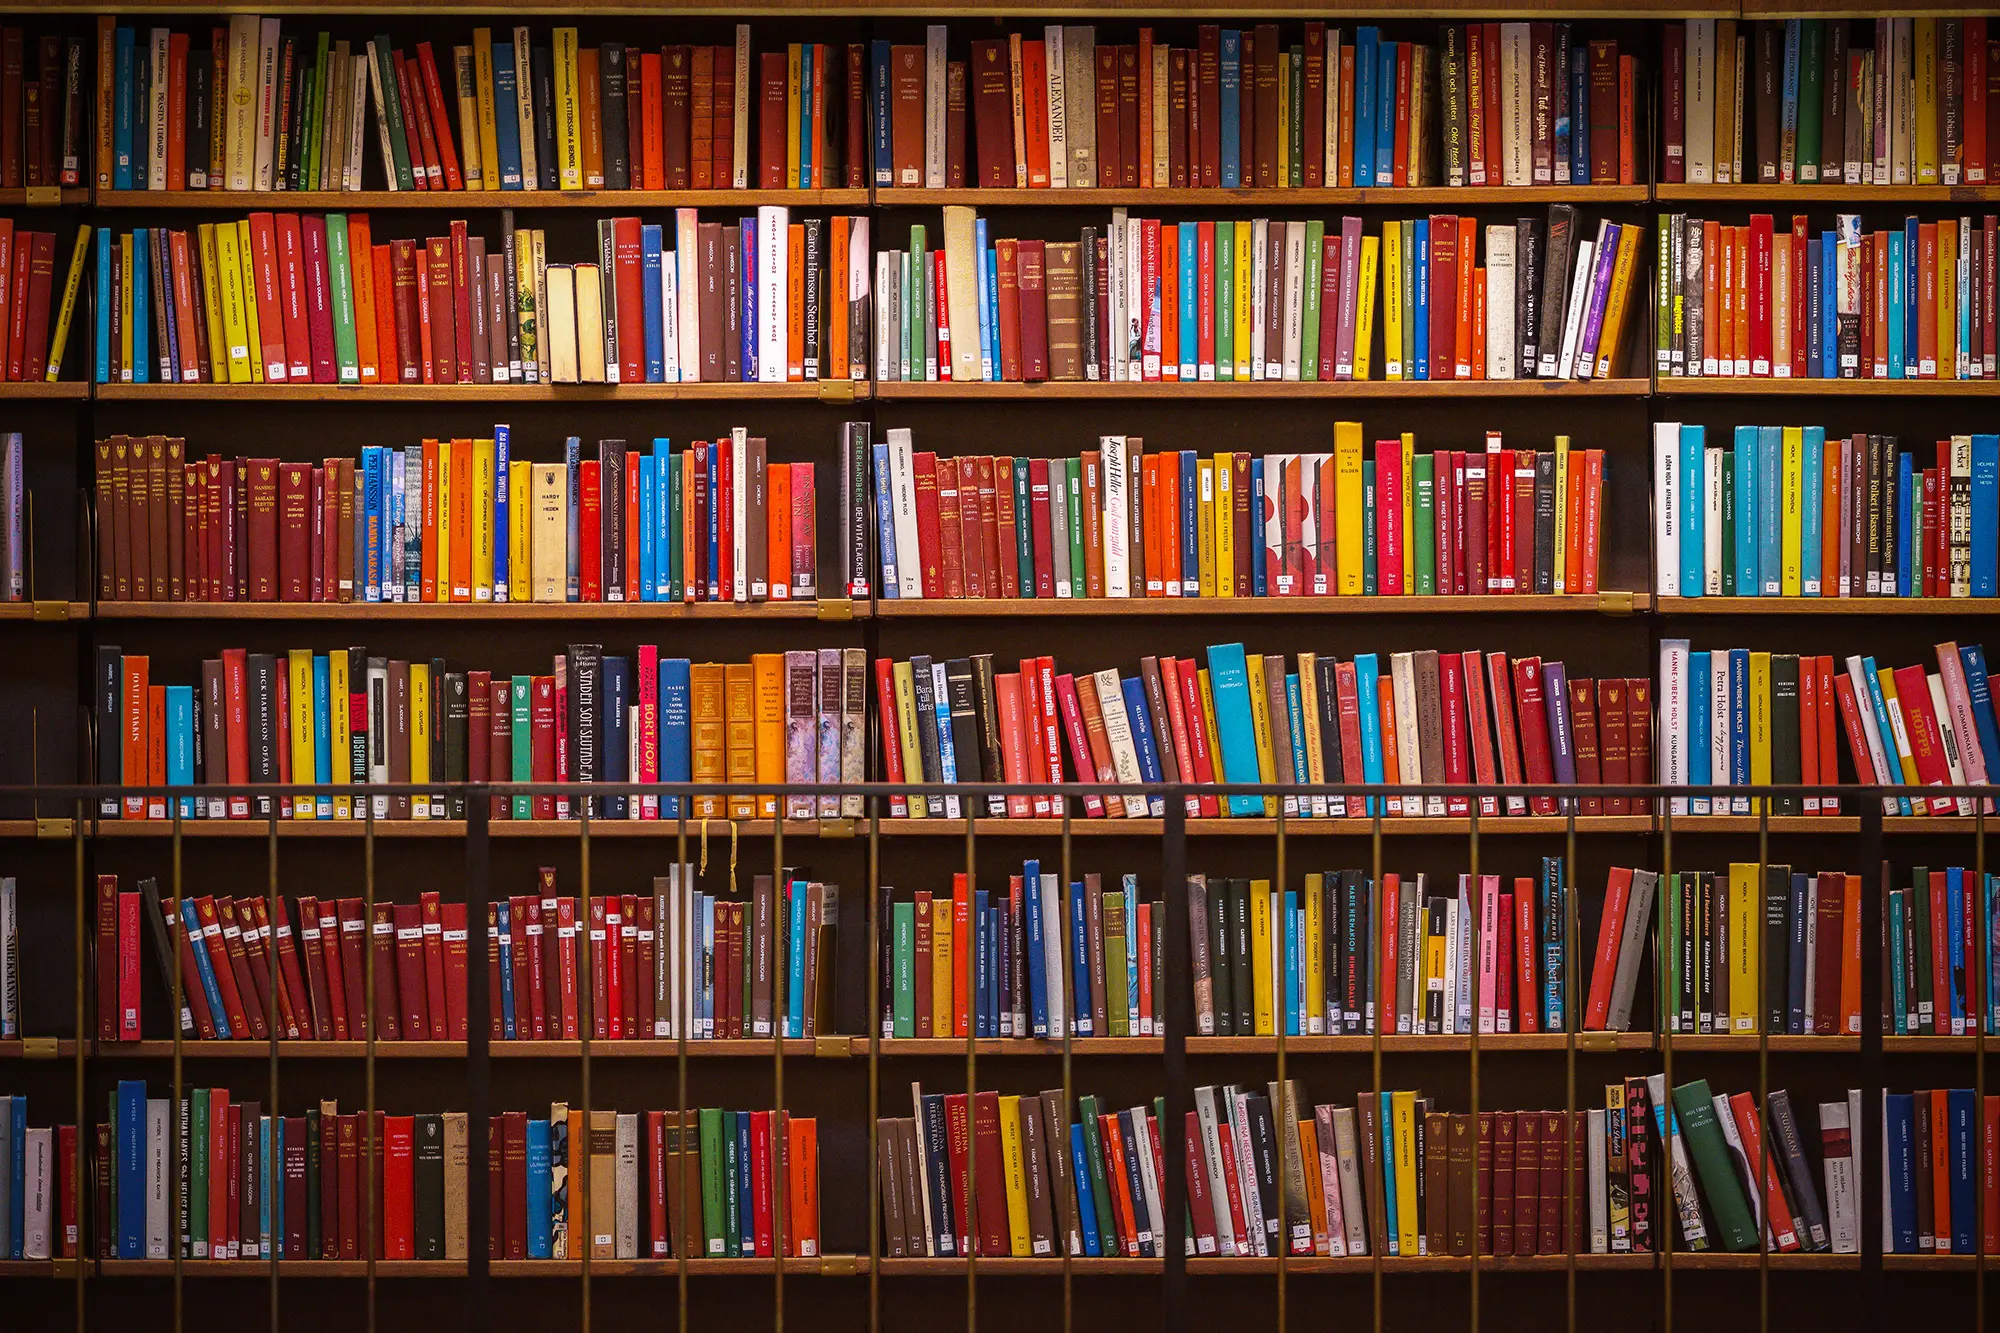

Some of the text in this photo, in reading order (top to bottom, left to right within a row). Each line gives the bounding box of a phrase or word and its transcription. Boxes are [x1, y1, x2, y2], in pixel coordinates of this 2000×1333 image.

[1448, 28, 1456, 57] Genom
[1537, 44, 1545, 60] Olof
[1945, 23, 1955, 59] Kärleken
[1449, 61, 1458, 75] Eld
[1946, 61, 1955, 73] till
[1449, 78, 1457, 93] och
[1471, 84, 1479, 109] Bajkal
[566, 98, 574, 137] PETTERSSON
[1051, 74, 1063, 142] ALEXANDER
[1538, 96, 1548, 110] Två
[1450, 127, 1459, 145] Olof
[1471, 114, 1480, 130] Olof
[1537, 113, 1547, 141] systrar
[1947, 109, 1955, 139] Tobias
[1947, 140, 1955, 156] Hill
[603, 237, 617, 364] Världsbilder Riber Hansson
[807, 227, 819, 346] Carola Hansson Steinhof
[1147, 263, 1155, 309] HEIMERSON
[1689, 226, 1701, 361] Staden Harriet Hjorth
[368, 454, 381, 471] PER
[1108, 438, 1122, 469] Joseph
[368, 472, 381, 511] HANSSON
[855, 461, 864, 503] HANDBERG
[1110, 467, 1122, 496] Heller
[1870, 480, 1879, 506] Folket
[1887, 481, 1895, 505] Änkans
[855, 507, 863, 522] DEN
[368, 515, 377, 548] MAMMA
[1870, 514, 1879, 553] Bassakull
[1886, 525, 1894, 538] natt
[855, 543, 863, 577] FLÄCKEN
[1884, 543, 1893, 564] skogen
[1042, 668, 1054, 716] hejbaberiba
[1290, 684, 1298, 707] Ernest
[1717, 671, 1726, 718] Petra Holst
[580, 670, 592, 770] STADEN SOM SLUTADE
[1292, 708, 1301, 747] Hemingway
[1910, 708, 1931, 757] HOPPE
[1956, 704, 1972, 750] DRÖMMARNAS
[1967, 751, 1976, 766] HUS
[353, 736, 365, 775] JOSEPHINE
[1047, 726, 1057, 754] gunnar
[645, 741, 654, 773] BORT
[1297, 760, 1303, 769] ha
[1298, 769, 1306, 783] och
[1549, 861, 1559, 888] Ralph
[1524, 936, 1529, 944] EN
[6, 935, 16, 1014] SAREKMANNEN
[1547, 945, 1561, 1012] Haberlands
[951, 1105, 963, 1154] HERRSTRÖM
[958, 1106, 968, 1152] CHRISTINA
[1238, 1101, 1251, 1138] CHRISTINA
[1780, 1112, 1798, 1152] NUNNAN
[1243, 1139, 1256, 1187] HESSELHOLDT
